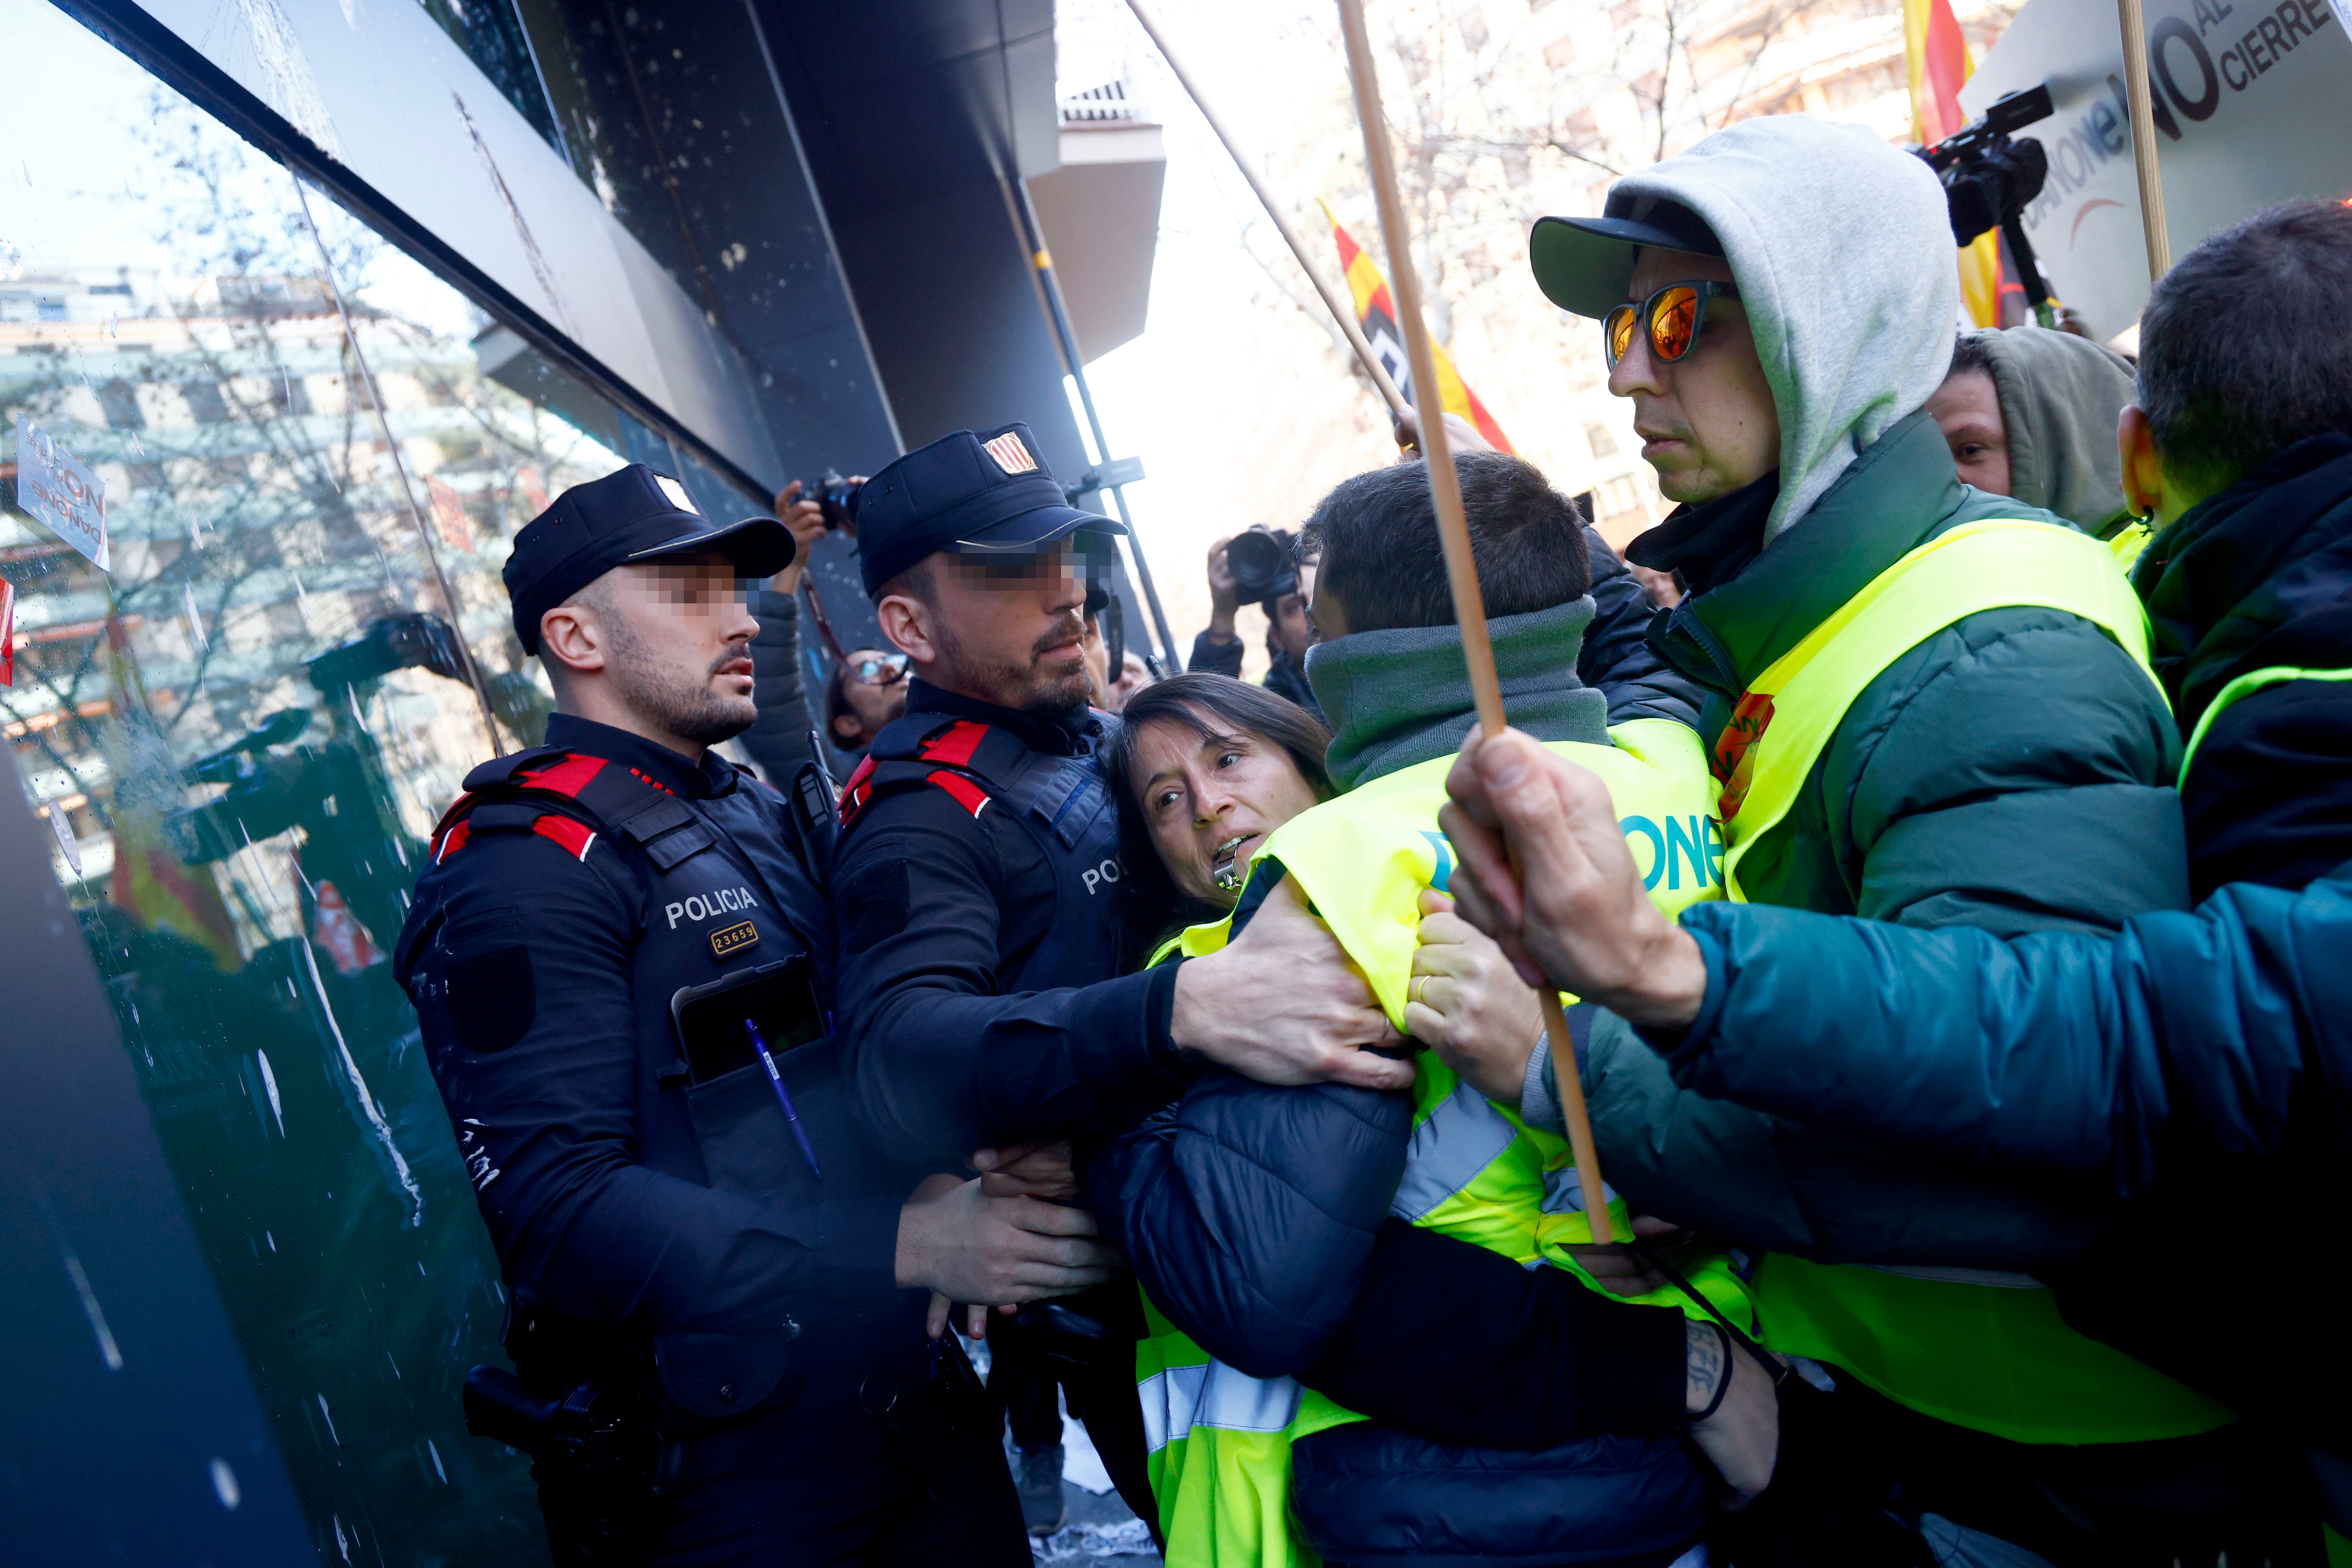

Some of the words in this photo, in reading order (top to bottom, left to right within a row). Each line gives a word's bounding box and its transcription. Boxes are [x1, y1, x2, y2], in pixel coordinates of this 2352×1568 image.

[2220, 0, 2331, 91] CIERRE
[64, 469, 103, 517] NO
[665, 887, 758, 930] POLICIA
[715, 927, 754, 948] 23659
